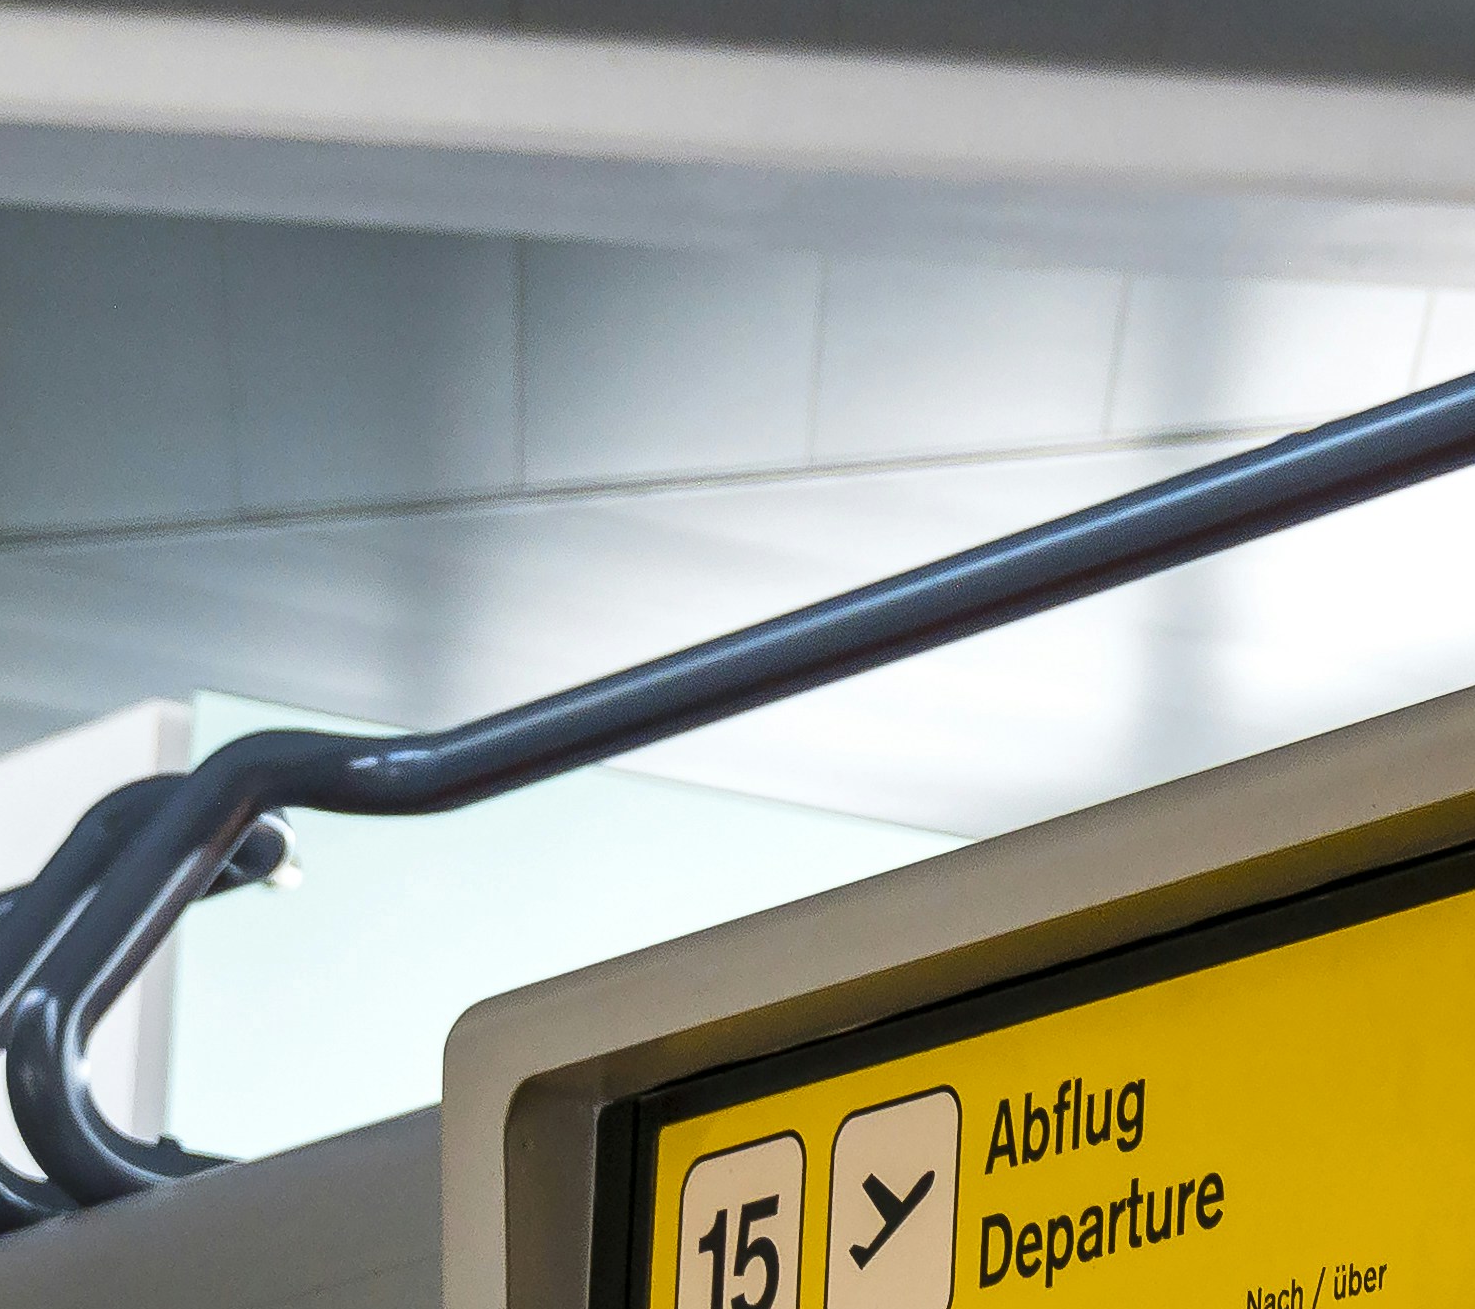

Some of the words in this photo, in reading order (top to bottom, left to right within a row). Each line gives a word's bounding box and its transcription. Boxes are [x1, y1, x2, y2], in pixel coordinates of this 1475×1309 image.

[984, 1078, 1146, 1175] Abflug
[979, 1172, 1225, 1289] Departure
[1333, 1262, 1388, 1301] über
